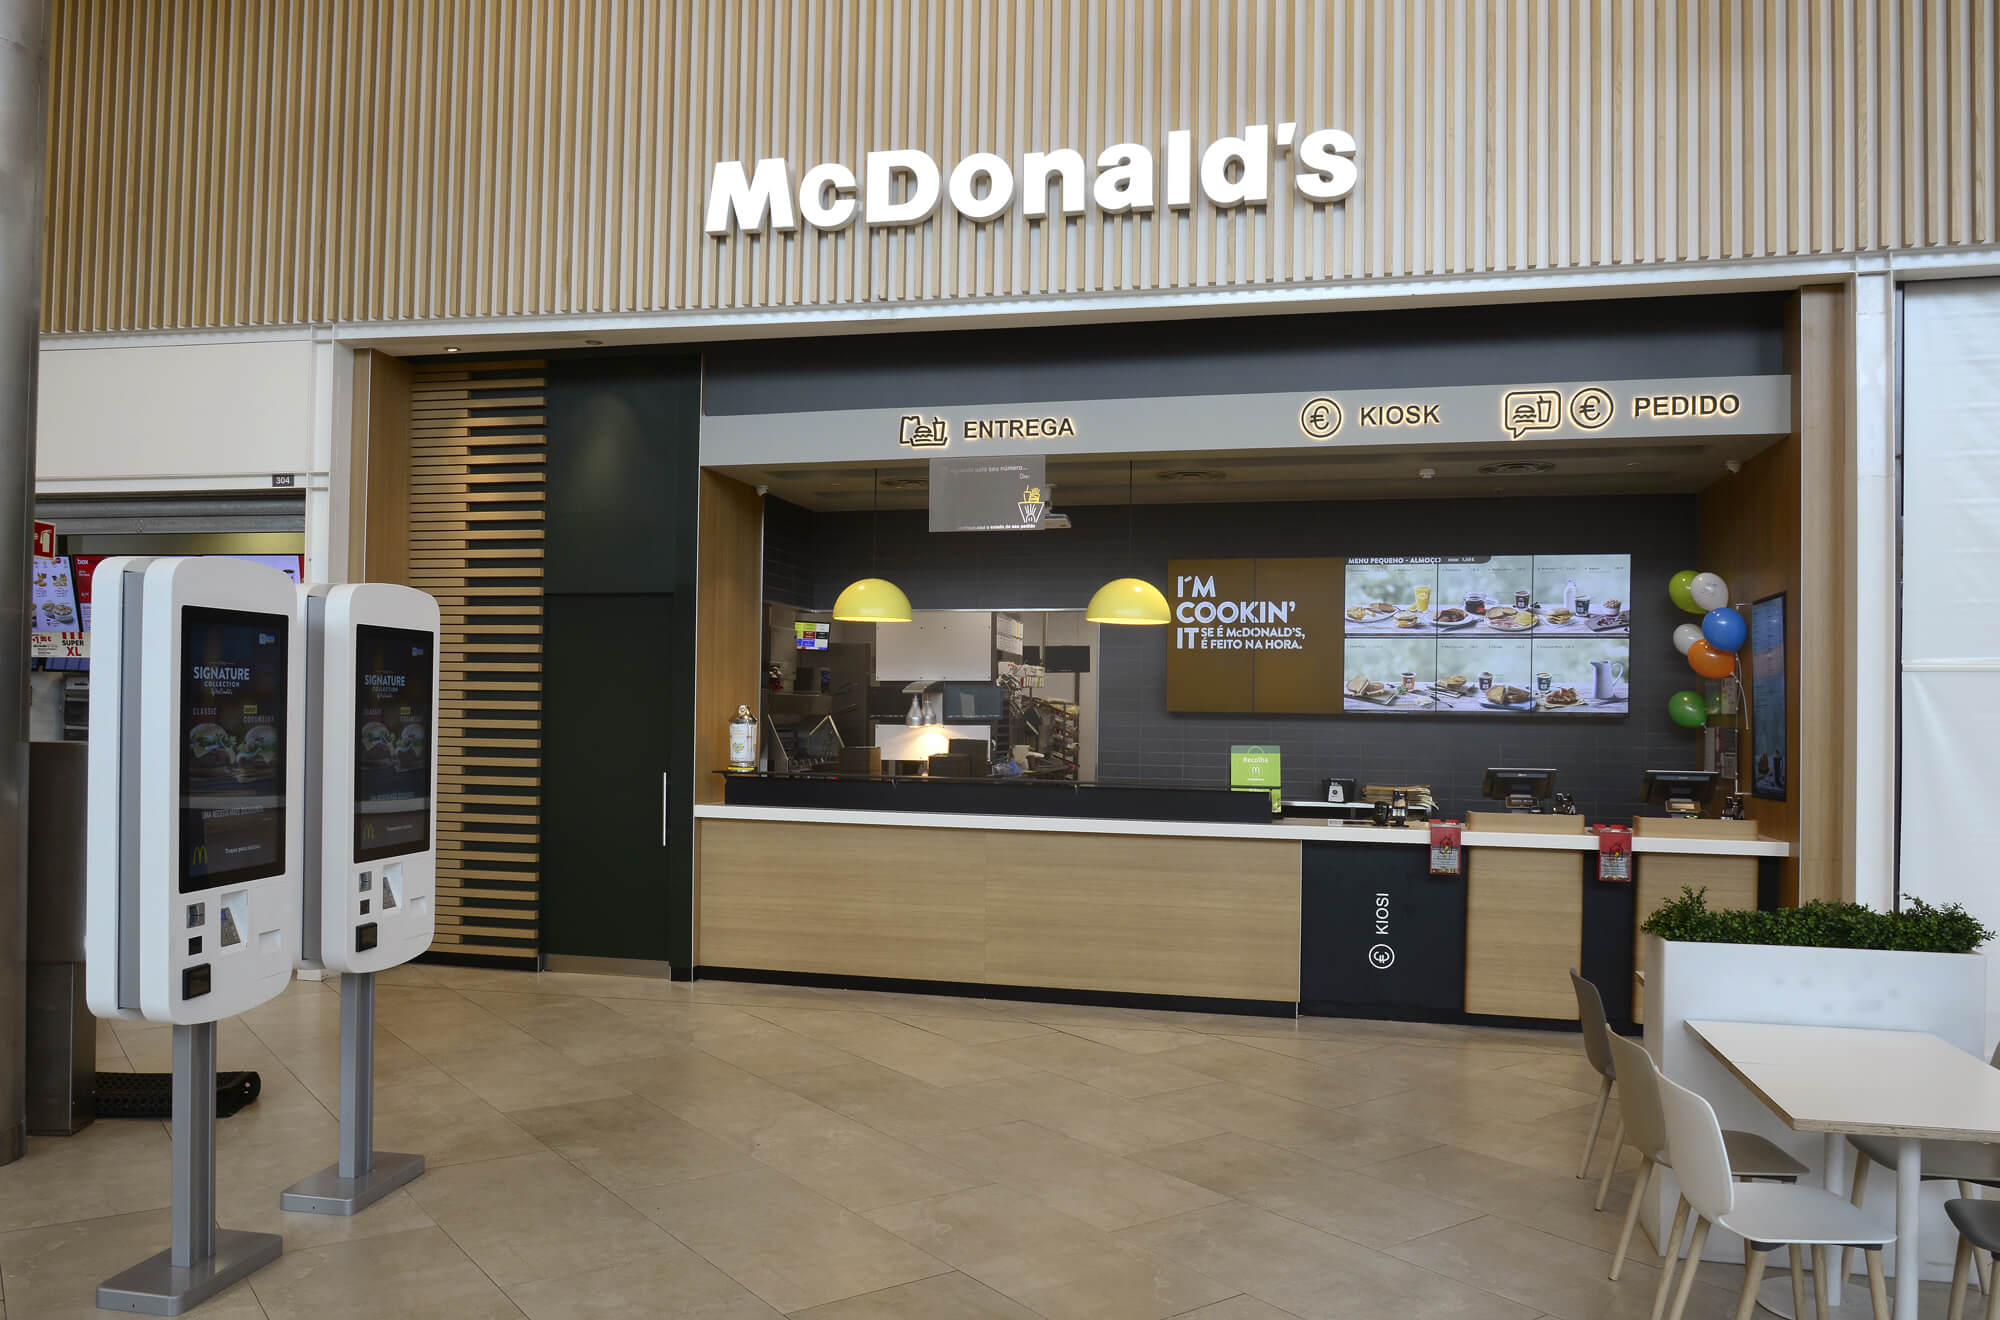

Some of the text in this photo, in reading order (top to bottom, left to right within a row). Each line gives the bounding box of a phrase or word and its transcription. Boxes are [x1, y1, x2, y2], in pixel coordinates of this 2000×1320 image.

[704, 121, 1358, 239] McDonald's
[1634, 393, 1740, 418] PEDIDO
[1359, 404, 1441, 426] KIOSK
[963, 417, 1075, 439] ENTREGA
[275, 475, 290, 485] 304
[1370, 557, 1404, 565] PEQUENO
[1410, 557, 1442, 566] ALMOÇO
[1175, 600, 1297, 624] COOKIN'
[1176, 627, 1200, 649] IT
[1200, 627, 1215, 637] SE
[1216, 624, 1224, 638] É
[1200, 636, 1303, 650] É FEITO NA HORA.
[66, 646, 83, 657] XL
[193, 665, 250, 681] SIGNATURE
[364, 674, 406, 687] SIGNATURE
